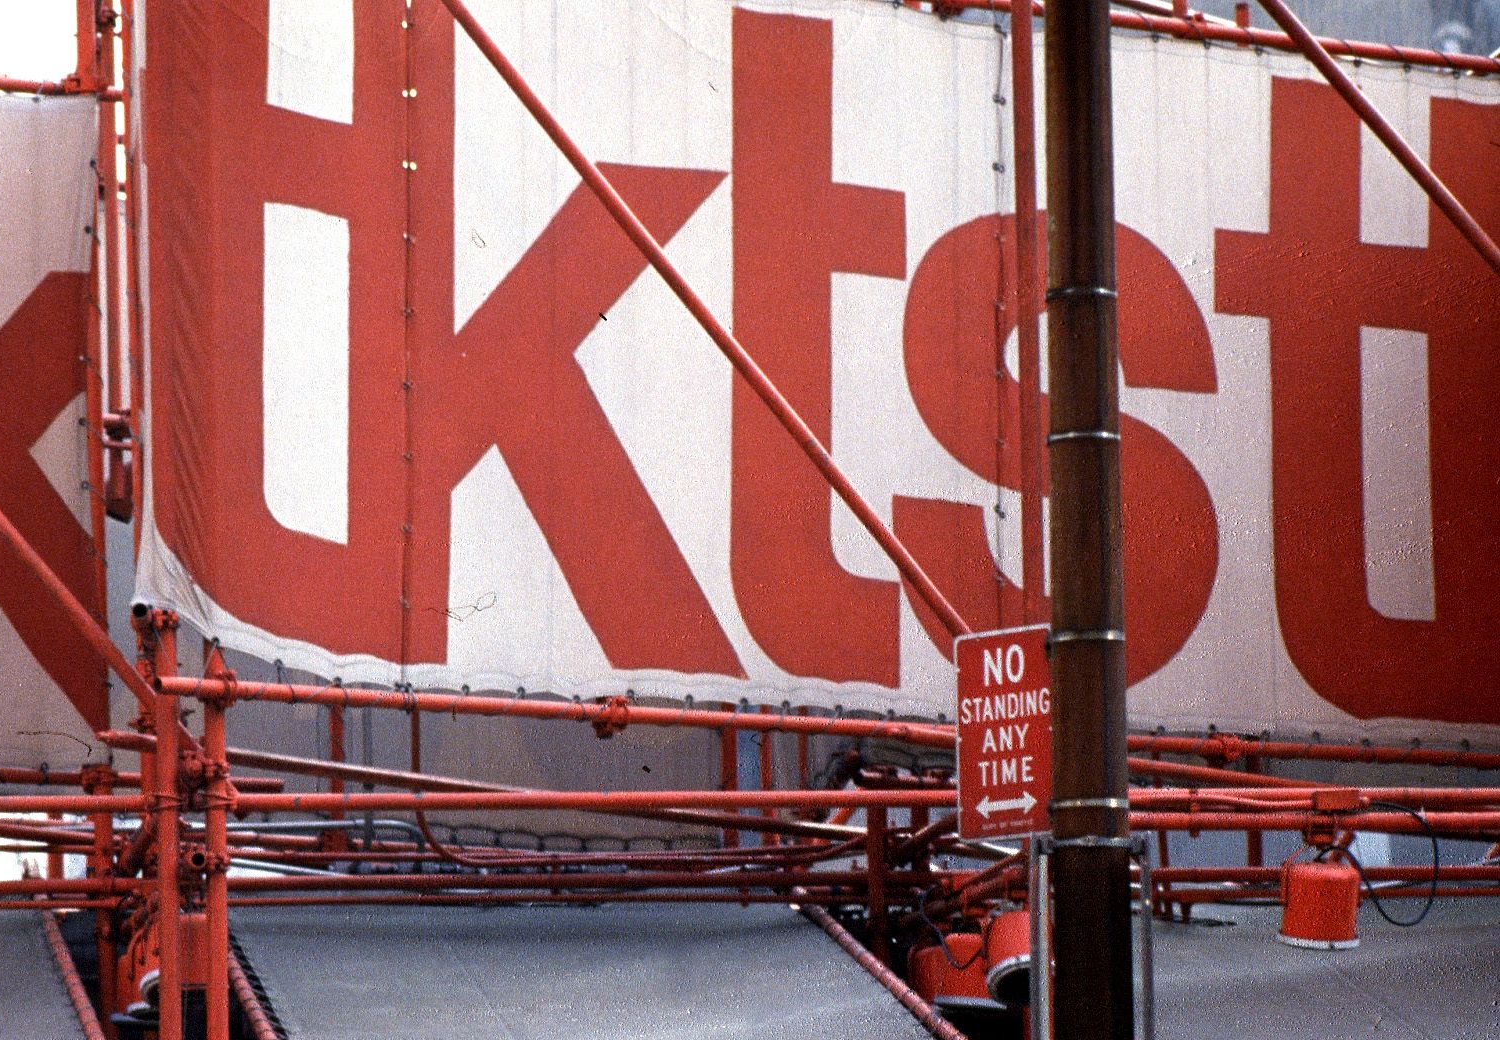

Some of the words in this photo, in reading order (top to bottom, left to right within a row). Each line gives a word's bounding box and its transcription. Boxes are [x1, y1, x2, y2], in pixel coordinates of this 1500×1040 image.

[982, 643, 1025, 687] NO
[960, 687, 1050, 725] STANDING
[982, 722, 1029, 753] ANY
[977, 755, 1034, 787] TIME
